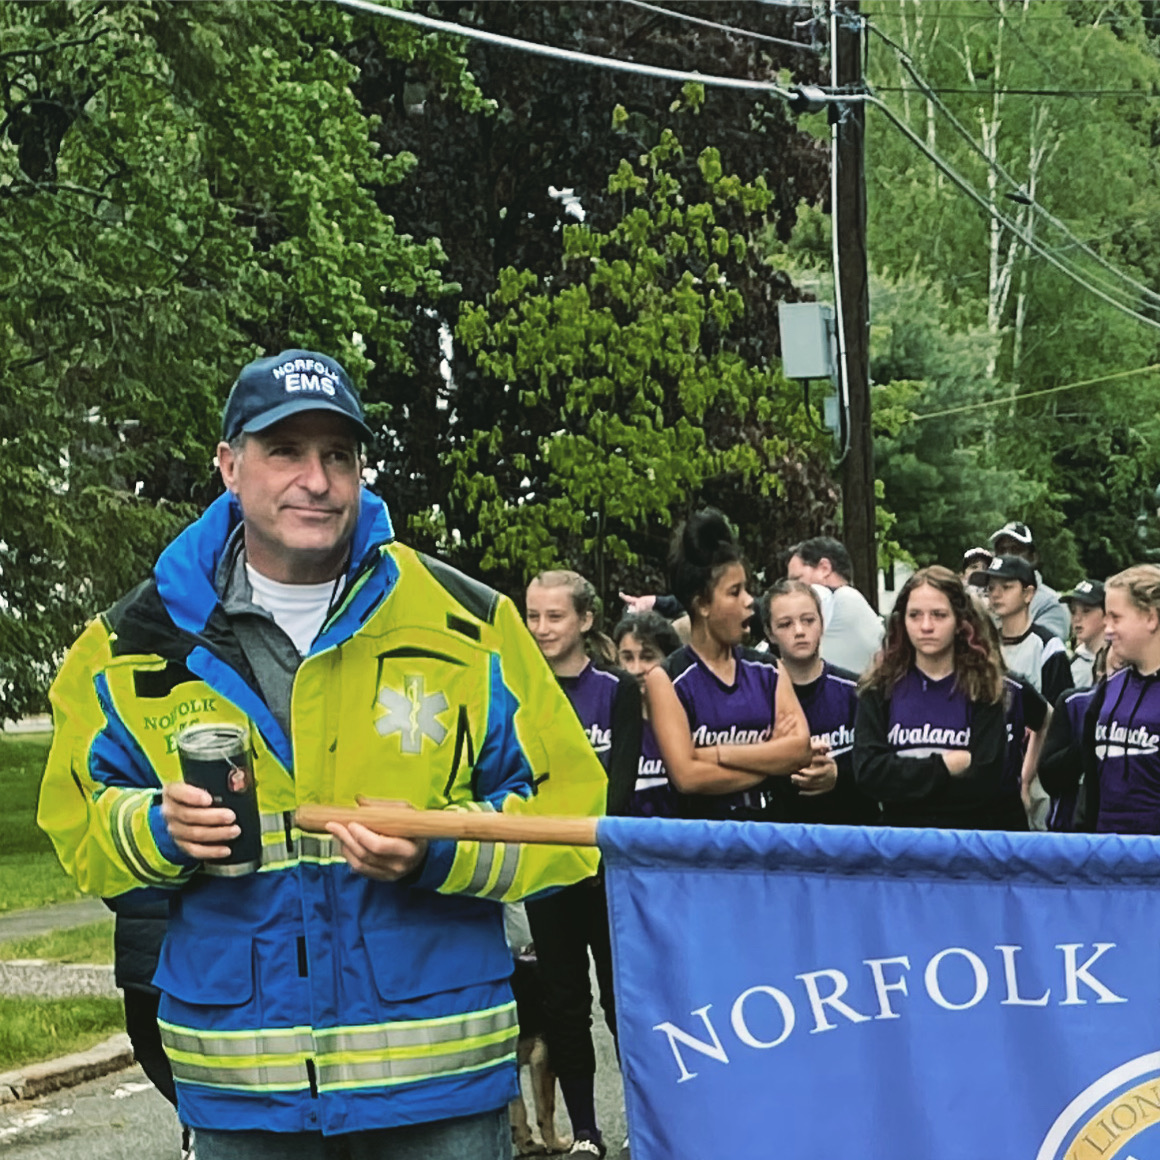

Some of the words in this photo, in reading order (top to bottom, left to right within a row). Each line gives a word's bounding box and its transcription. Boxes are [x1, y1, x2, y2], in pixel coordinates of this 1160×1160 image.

[272, 359, 340, 386] NORFOLK
[285, 373, 336, 396] EMS
[691, 724, 772, 746] Avalanc
[887, 722, 971, 747] Avalanc
[653, 943, 1127, 1082] NORFOLK
